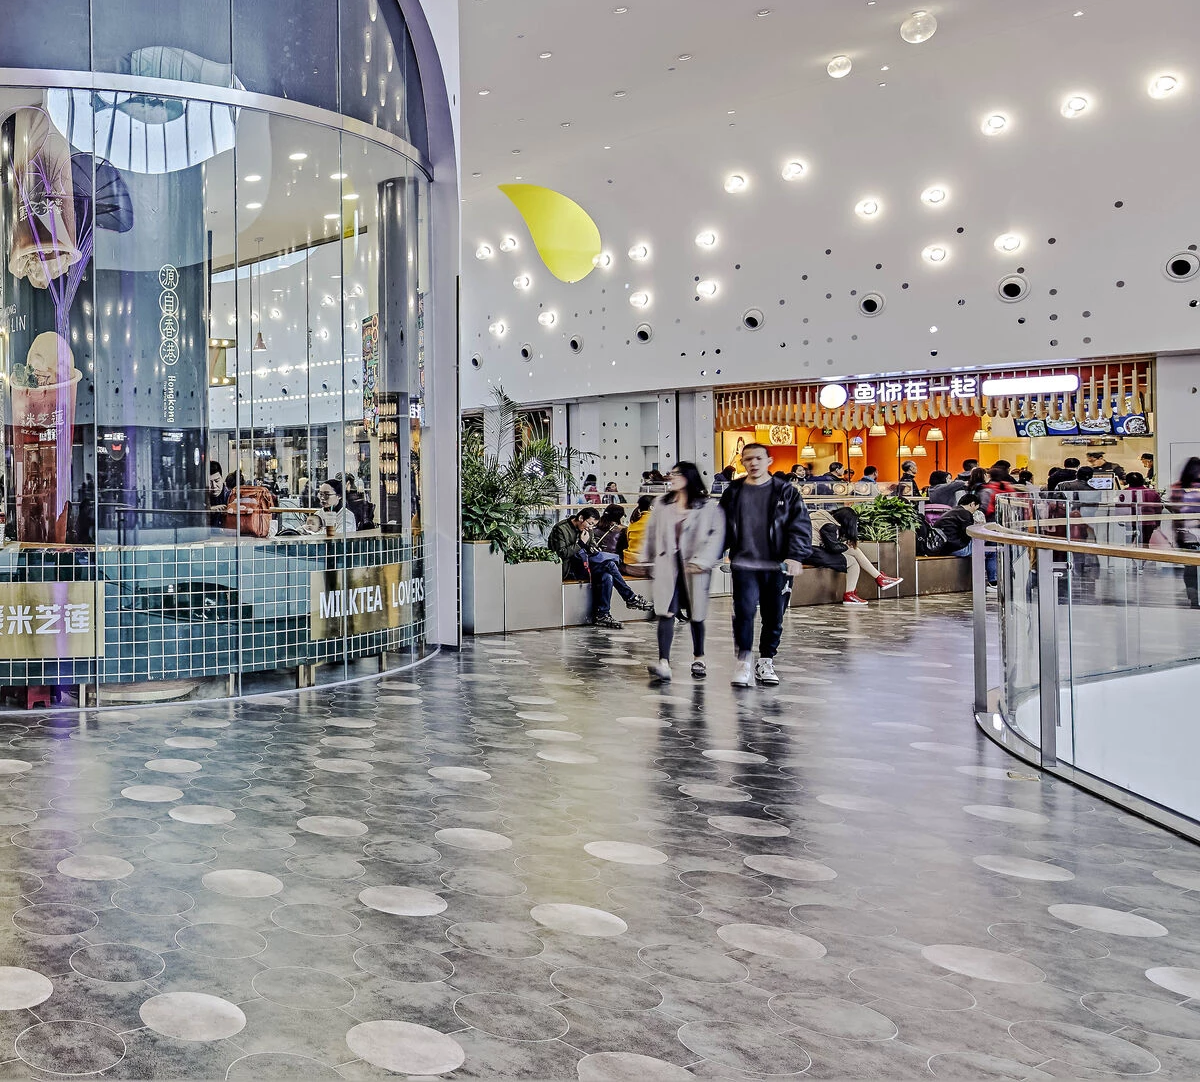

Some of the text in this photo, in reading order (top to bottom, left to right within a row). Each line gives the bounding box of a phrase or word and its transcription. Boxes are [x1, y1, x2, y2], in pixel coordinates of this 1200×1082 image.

[160, 266, 178, 363] 源自香港
[166, 375, 178, 423] Hongkong
[854, 378, 976, 404] 鱼你在一起
[319, 577, 425, 619] MILKTEA LOVERS
